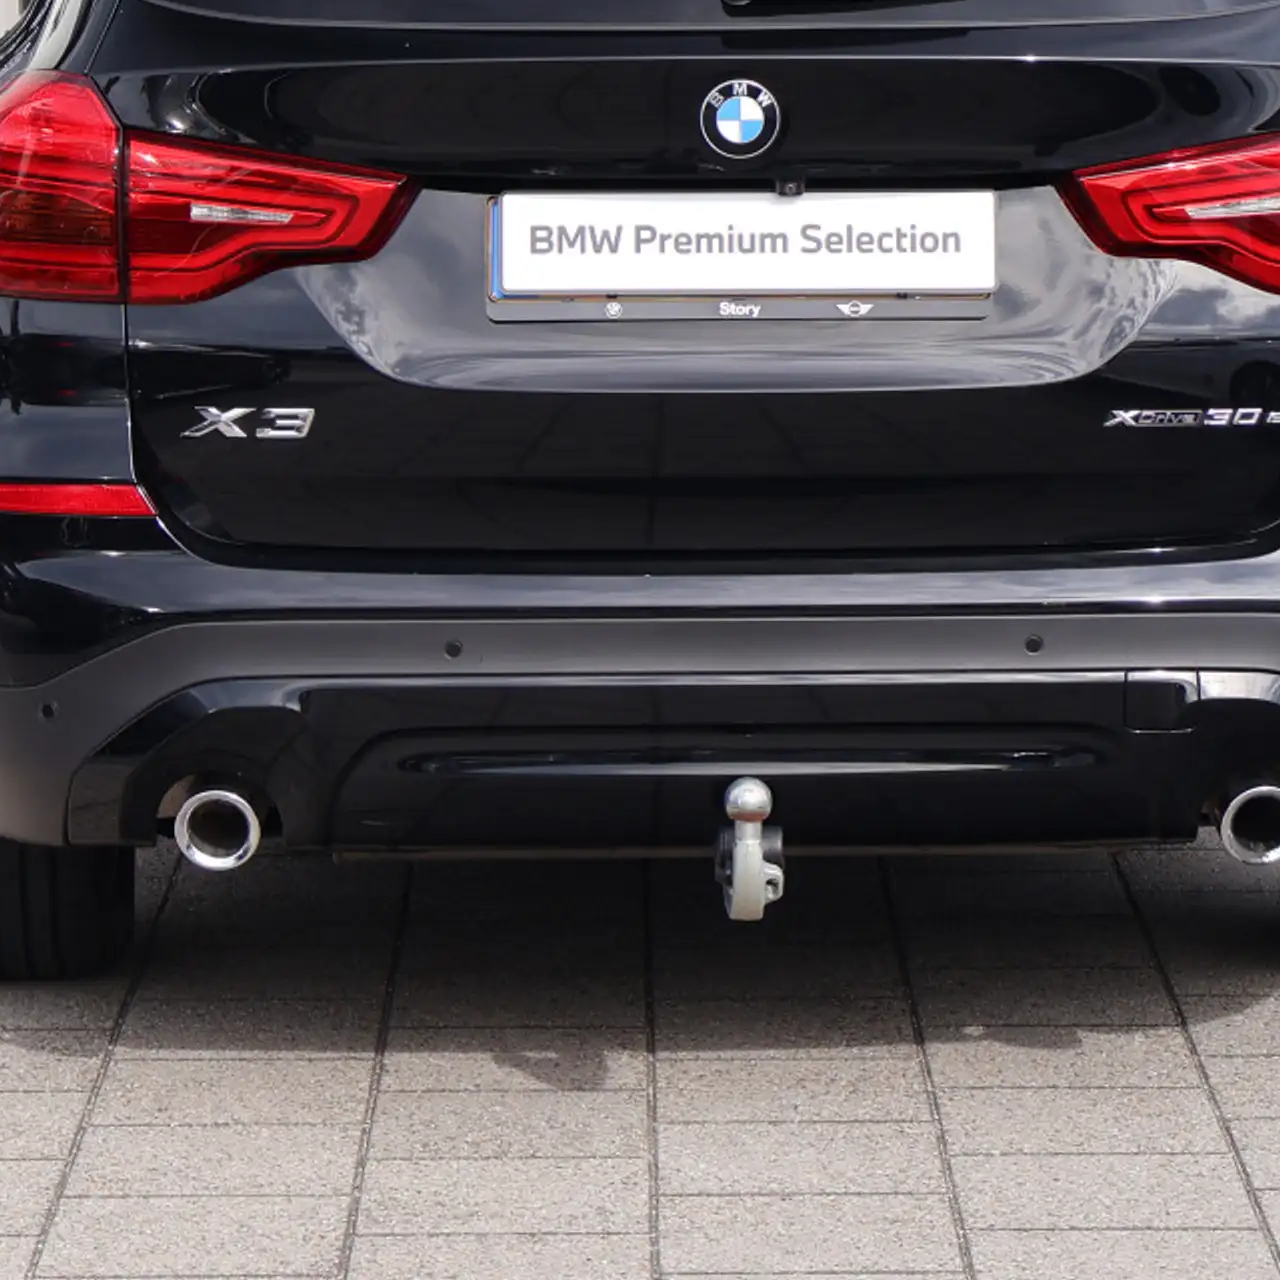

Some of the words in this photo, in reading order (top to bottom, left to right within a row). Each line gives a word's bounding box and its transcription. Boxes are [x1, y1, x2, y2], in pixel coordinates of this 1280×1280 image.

[528, 224, 624, 255] BMW
[634, 224, 789, 255] Premium
[800, 224, 962, 254] Selection
[719, 301, 762, 318] Story
[179, 406, 316, 439] X3
